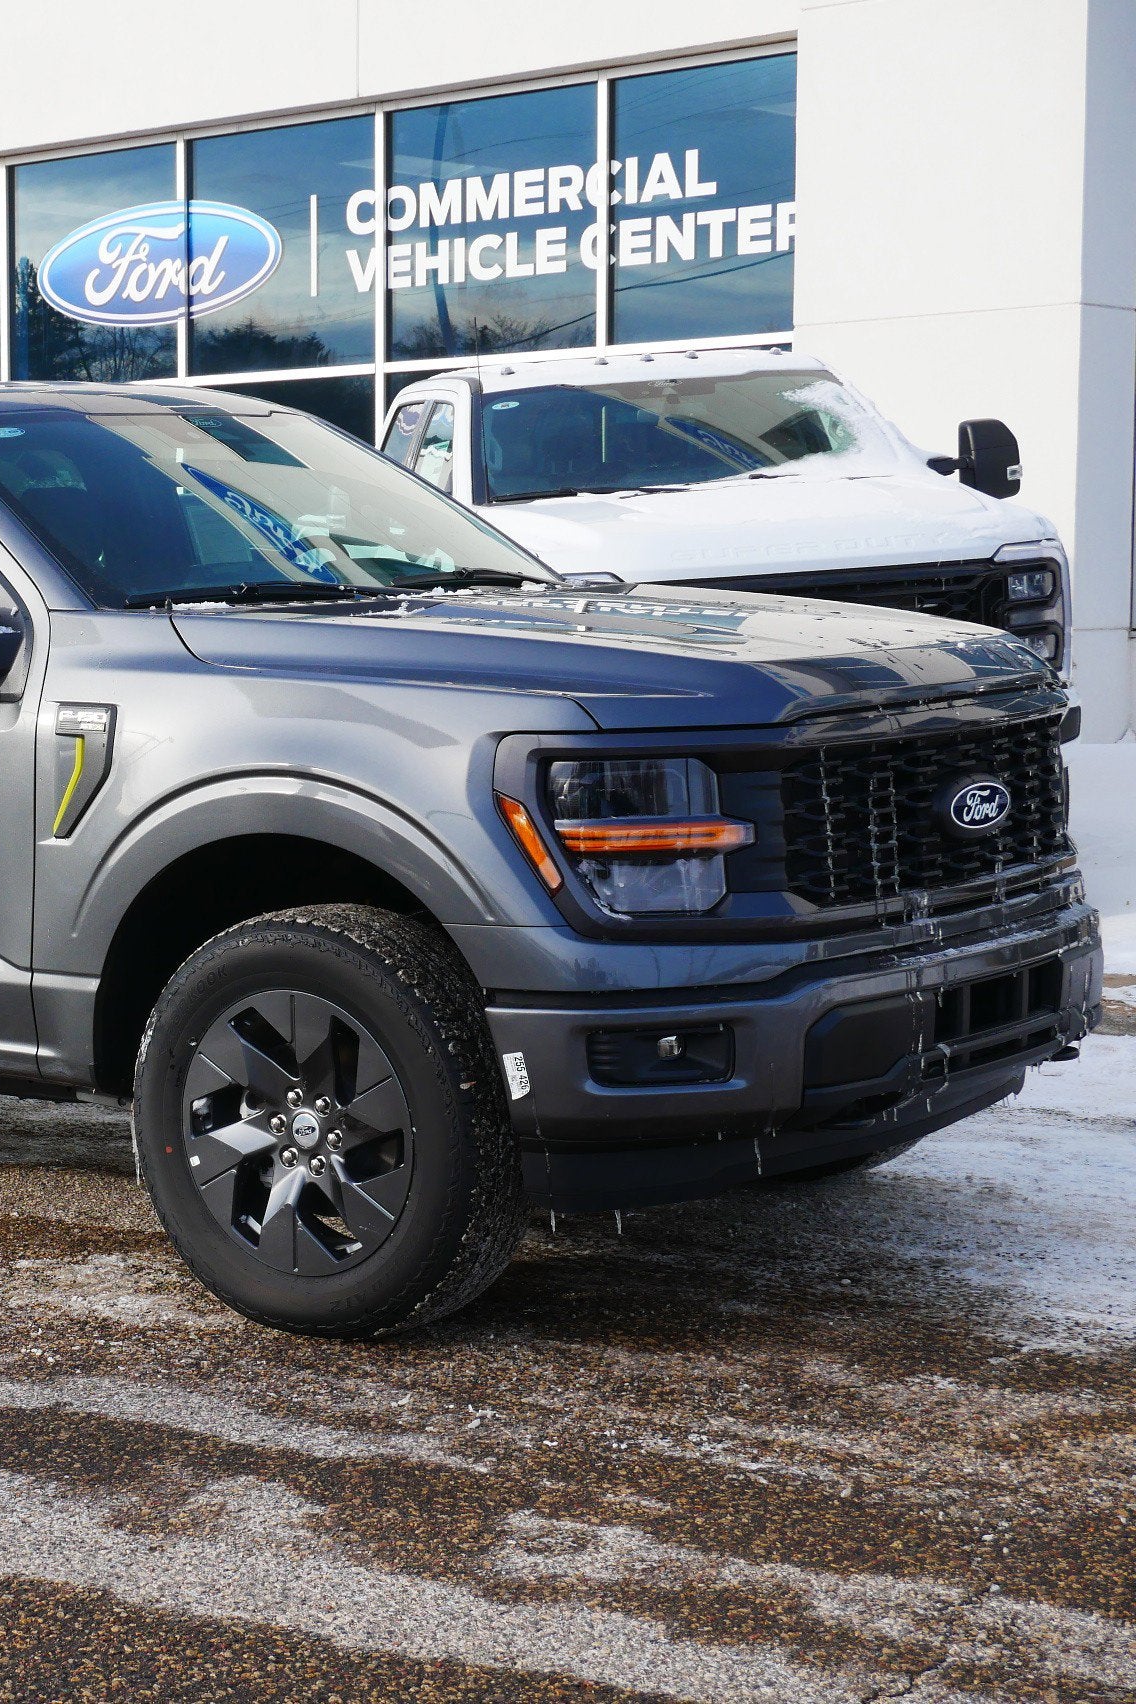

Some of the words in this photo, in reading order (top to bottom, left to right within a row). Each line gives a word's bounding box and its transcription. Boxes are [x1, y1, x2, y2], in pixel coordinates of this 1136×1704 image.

[346, 149, 717, 236] COMMERCIAL
[85, 222, 229, 306] Ford
[346, 226, 567, 293] VEHICLE
[963, 789, 999, 822] Ford
[513, 1056, 526, 1072] 255
